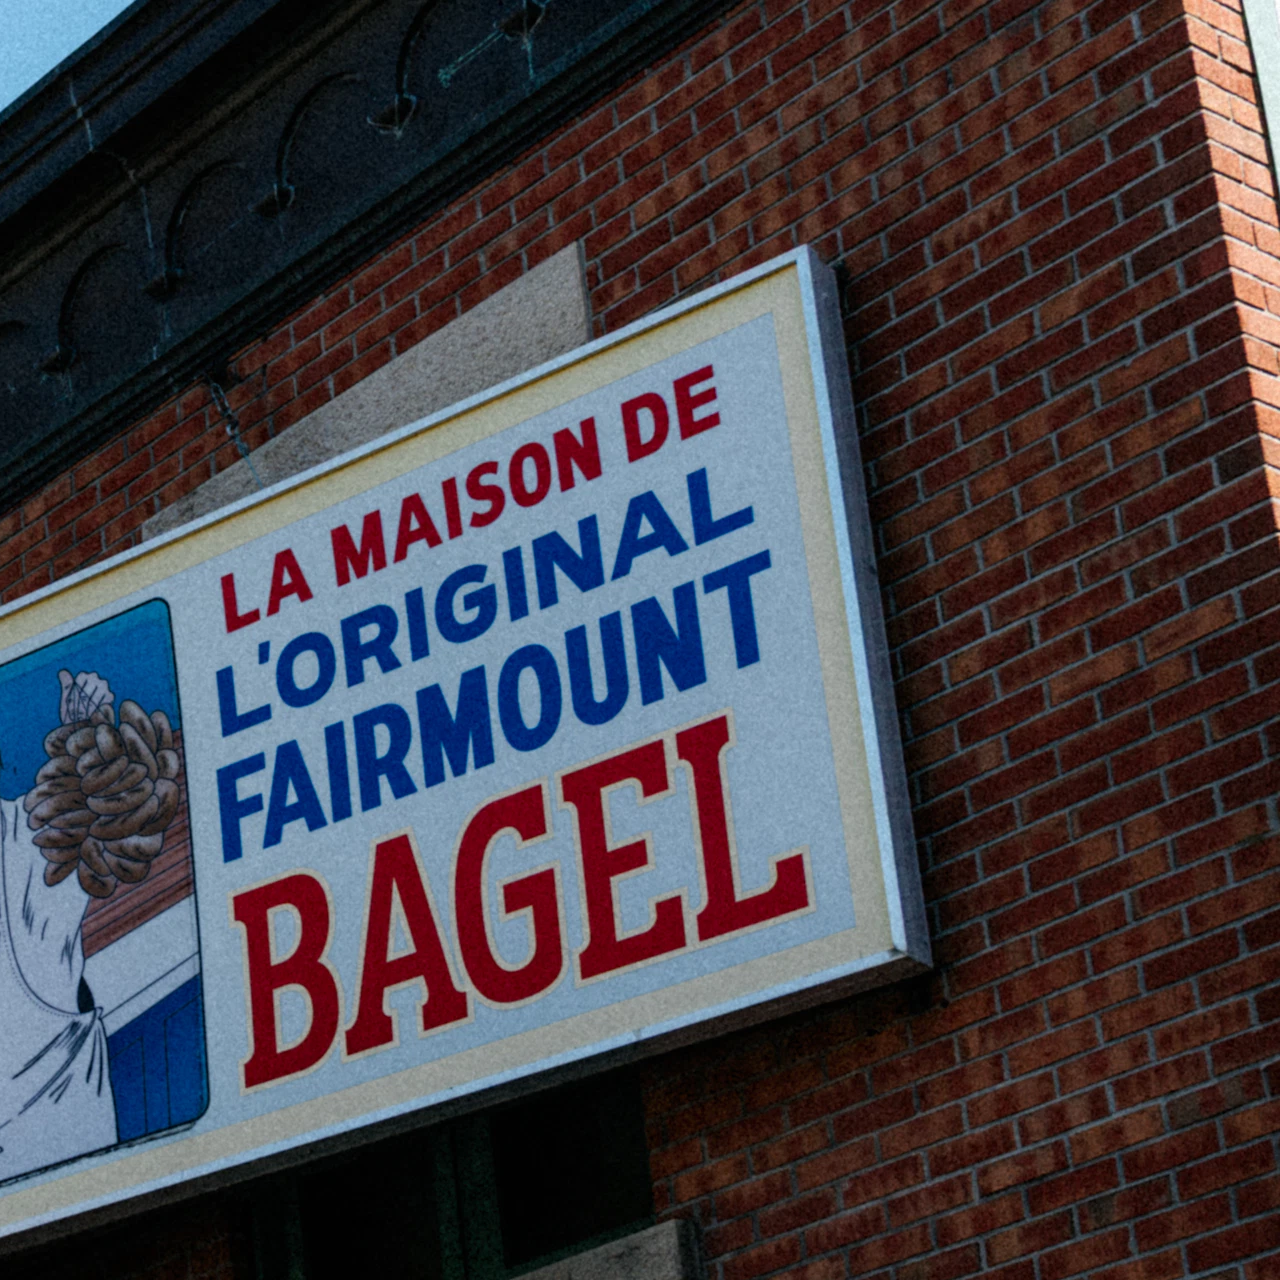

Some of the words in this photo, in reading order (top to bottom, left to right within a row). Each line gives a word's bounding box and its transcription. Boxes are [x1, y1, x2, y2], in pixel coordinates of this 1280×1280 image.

[214, 466, 756, 738] L'ORIGINAL
[220, 548, 315, 634] LA
[330, 415, 604, 588] MAISON
[621, 364, 722, 463] DE
[215, 548, 773, 865] FAIRMOUNT
[231, 713, 811, 1090] BAGEL
